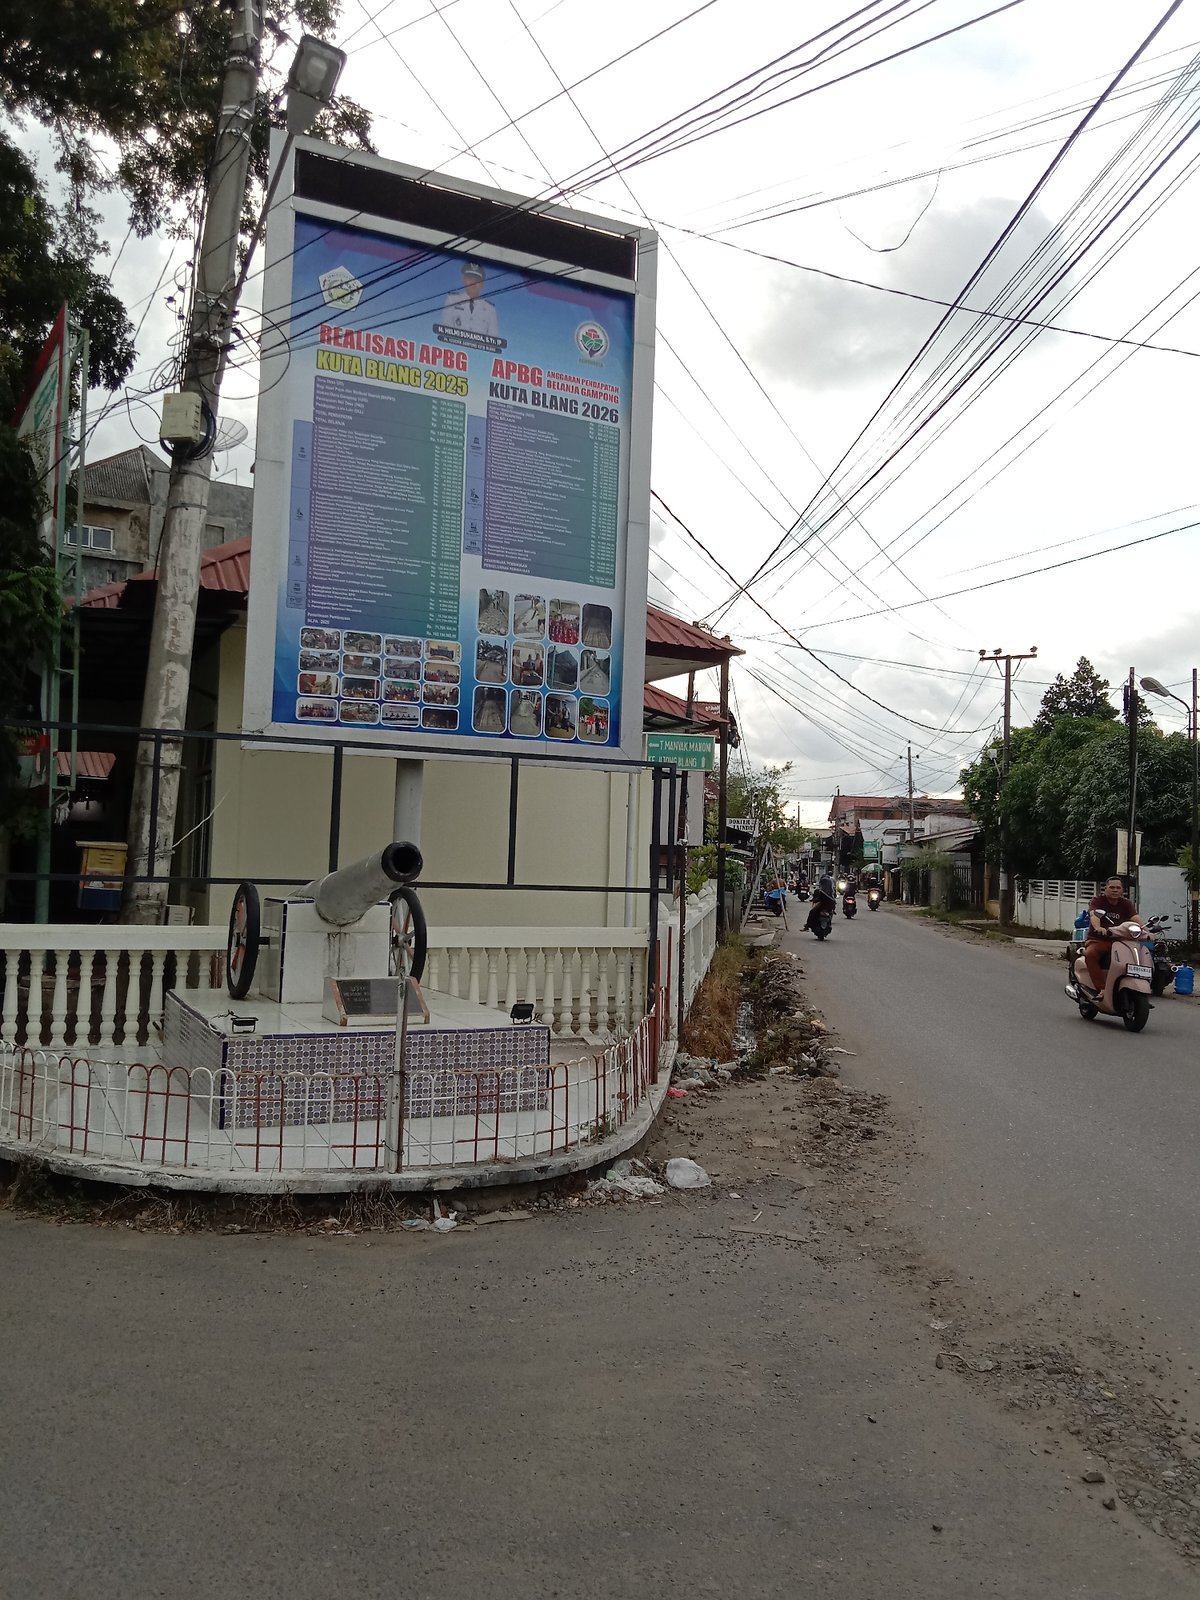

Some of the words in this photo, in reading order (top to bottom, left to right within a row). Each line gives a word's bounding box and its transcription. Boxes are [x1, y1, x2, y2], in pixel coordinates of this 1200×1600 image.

[320, 324, 415, 362] REALISASI
[419, 344, 468, 371] APBG
[317, 350, 362, 376] KUTA
[365, 359, 421, 387] BLANG
[424, 370, 468, 396] 2025
[491, 358, 543, 387] APBG
[547, 370, 580, 383] ANGGARAN
[581, 378, 620, 393] PENDAPATAN
[489, 381, 528, 404] KUTA
[531, 390, 578, 415] BLANG
[581, 402, 619, 423] 2026
[546, 379, 580, 395] BELANJA
[581, 387, 619, 403] GAMPONG
